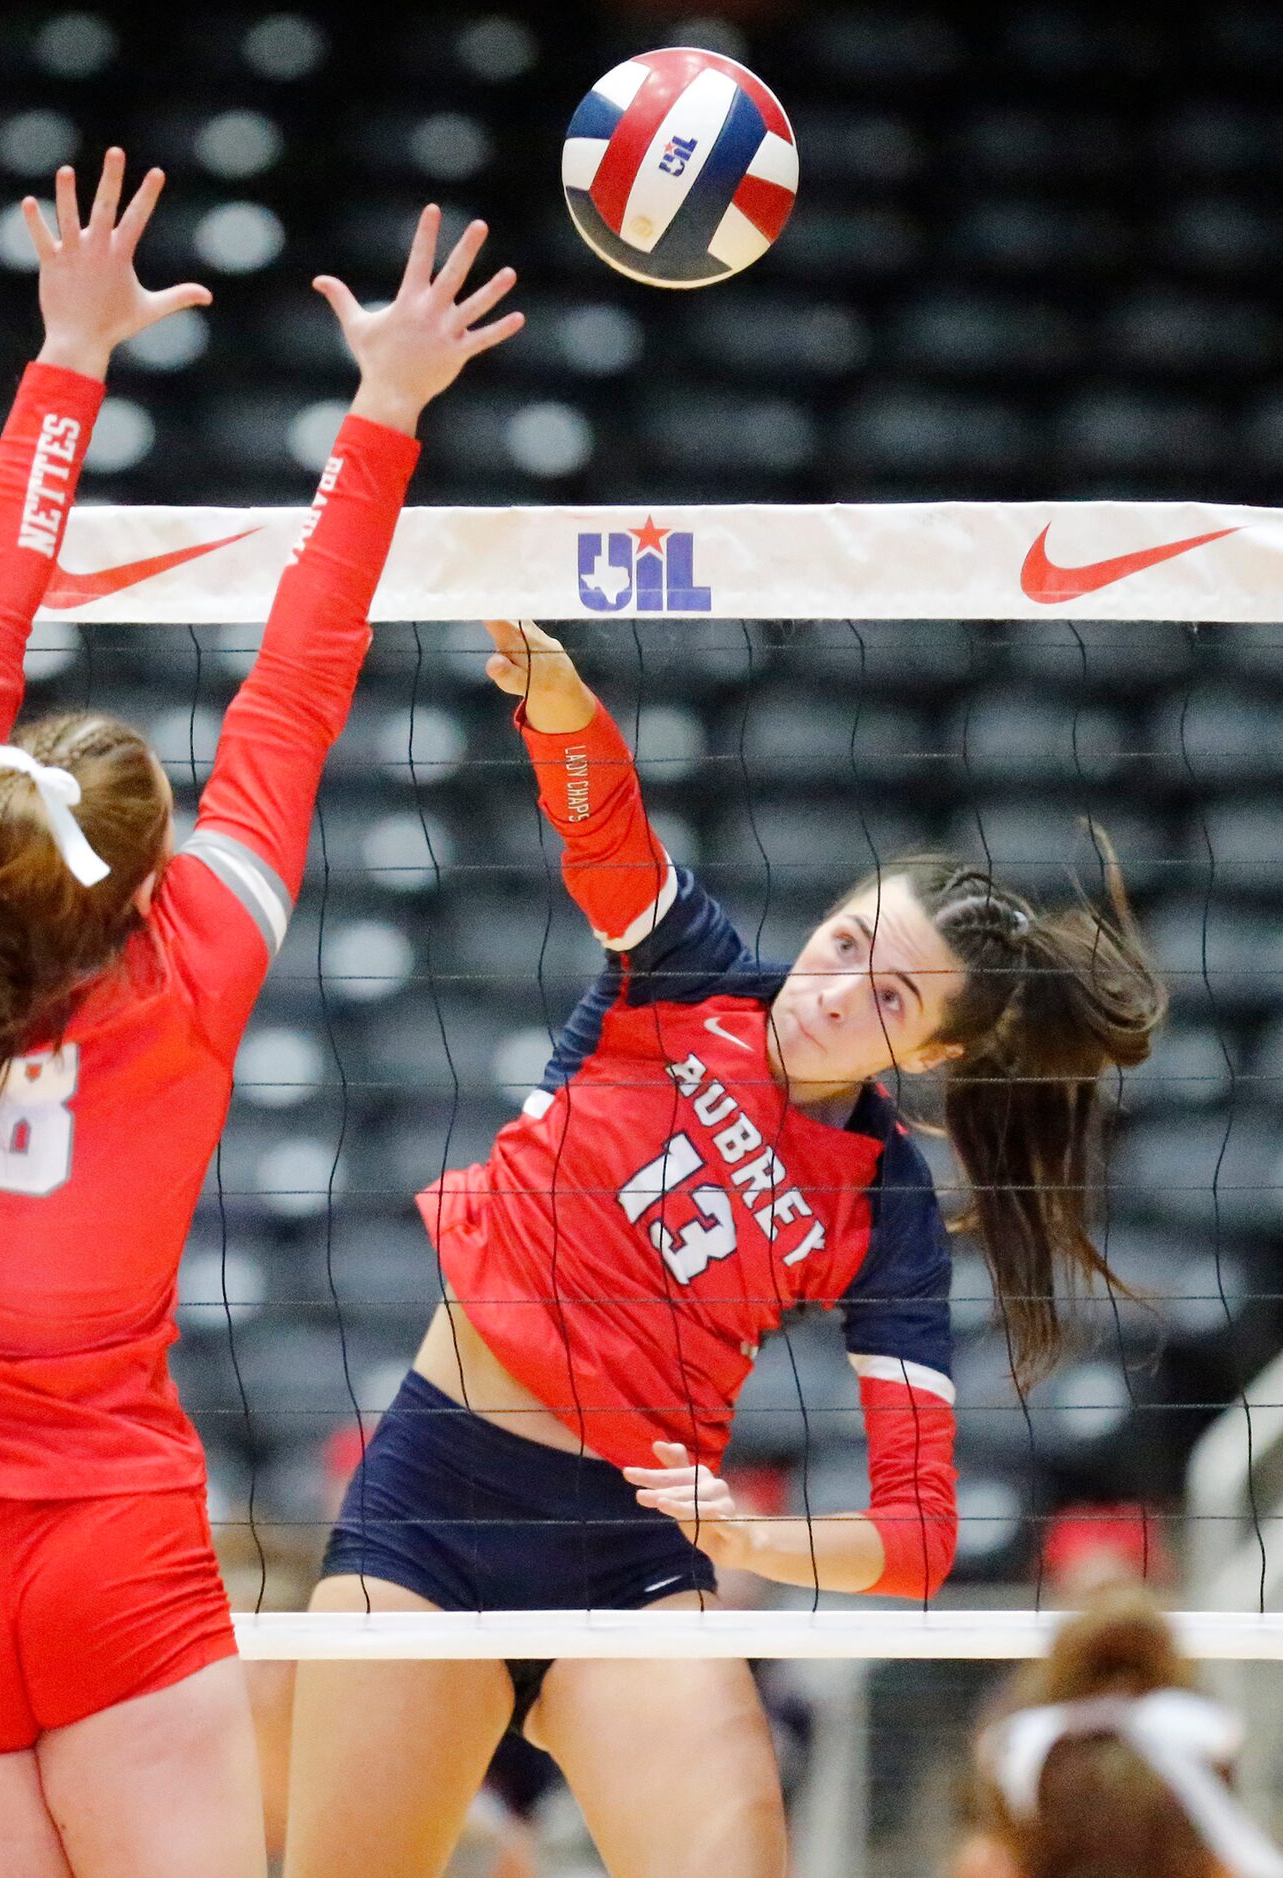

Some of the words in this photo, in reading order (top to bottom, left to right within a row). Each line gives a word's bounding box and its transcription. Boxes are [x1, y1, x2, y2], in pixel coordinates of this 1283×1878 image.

[17, 413, 81, 559] NETTES
[564, 745, 589, 778] LADY
[566, 780, 591, 823] CHAPS
[618, 1131, 738, 1286] 13
[666, 1052, 826, 1267] AUBREY
